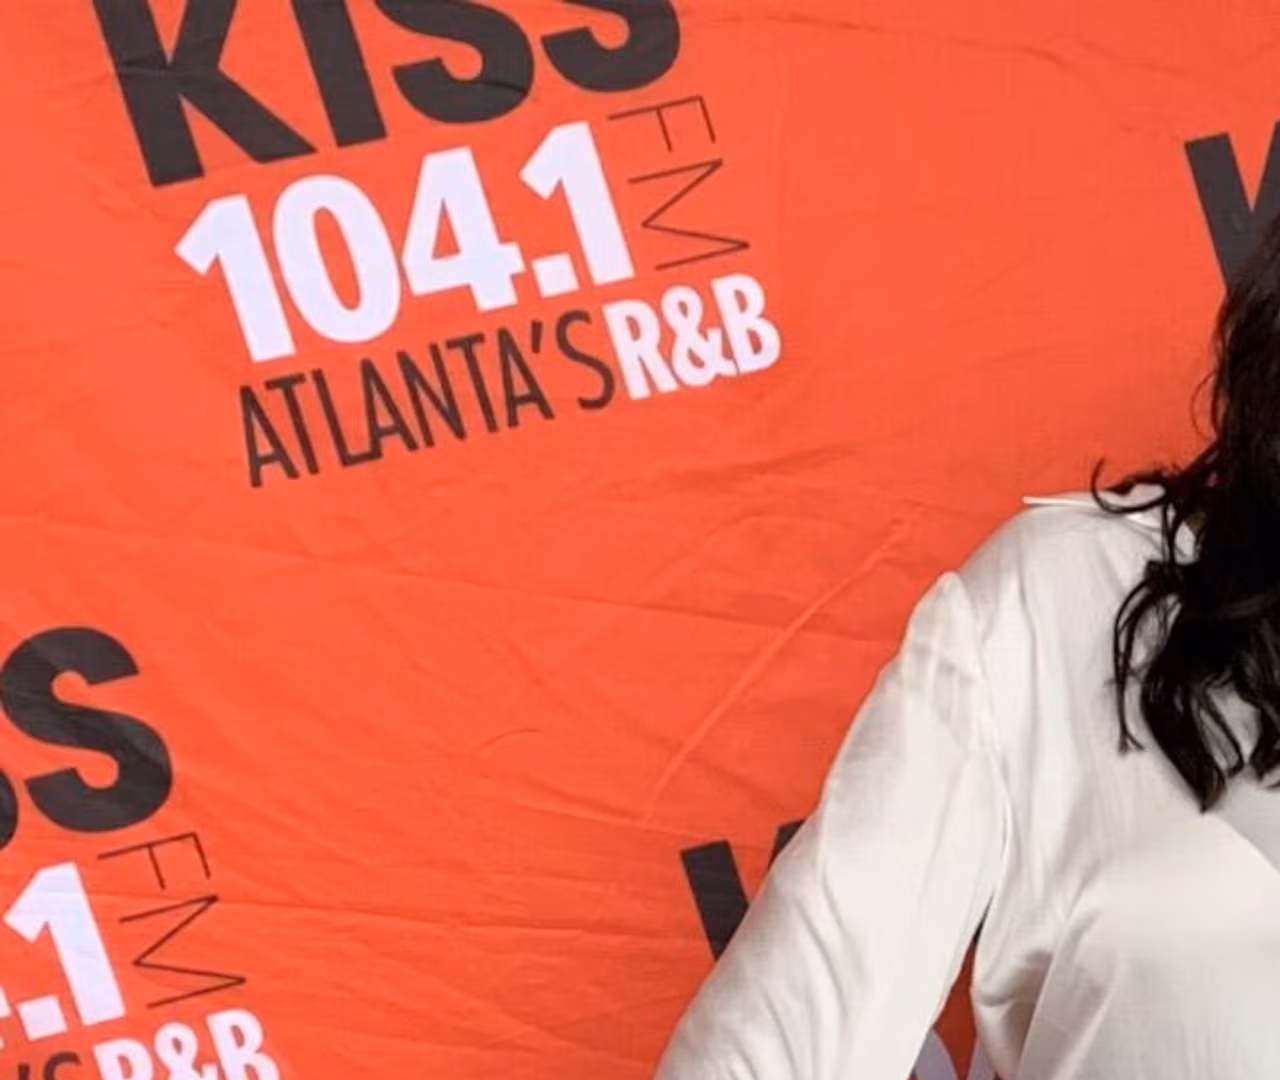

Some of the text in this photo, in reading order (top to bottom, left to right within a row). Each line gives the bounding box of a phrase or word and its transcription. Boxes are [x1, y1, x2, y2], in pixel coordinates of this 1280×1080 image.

[174, 121, 636, 363] 104.1
[606, 95, 750, 271] FM
[239, 273, 782, 488] ATLANTA'S R&B
[97, 832, 247, 1008] FM
